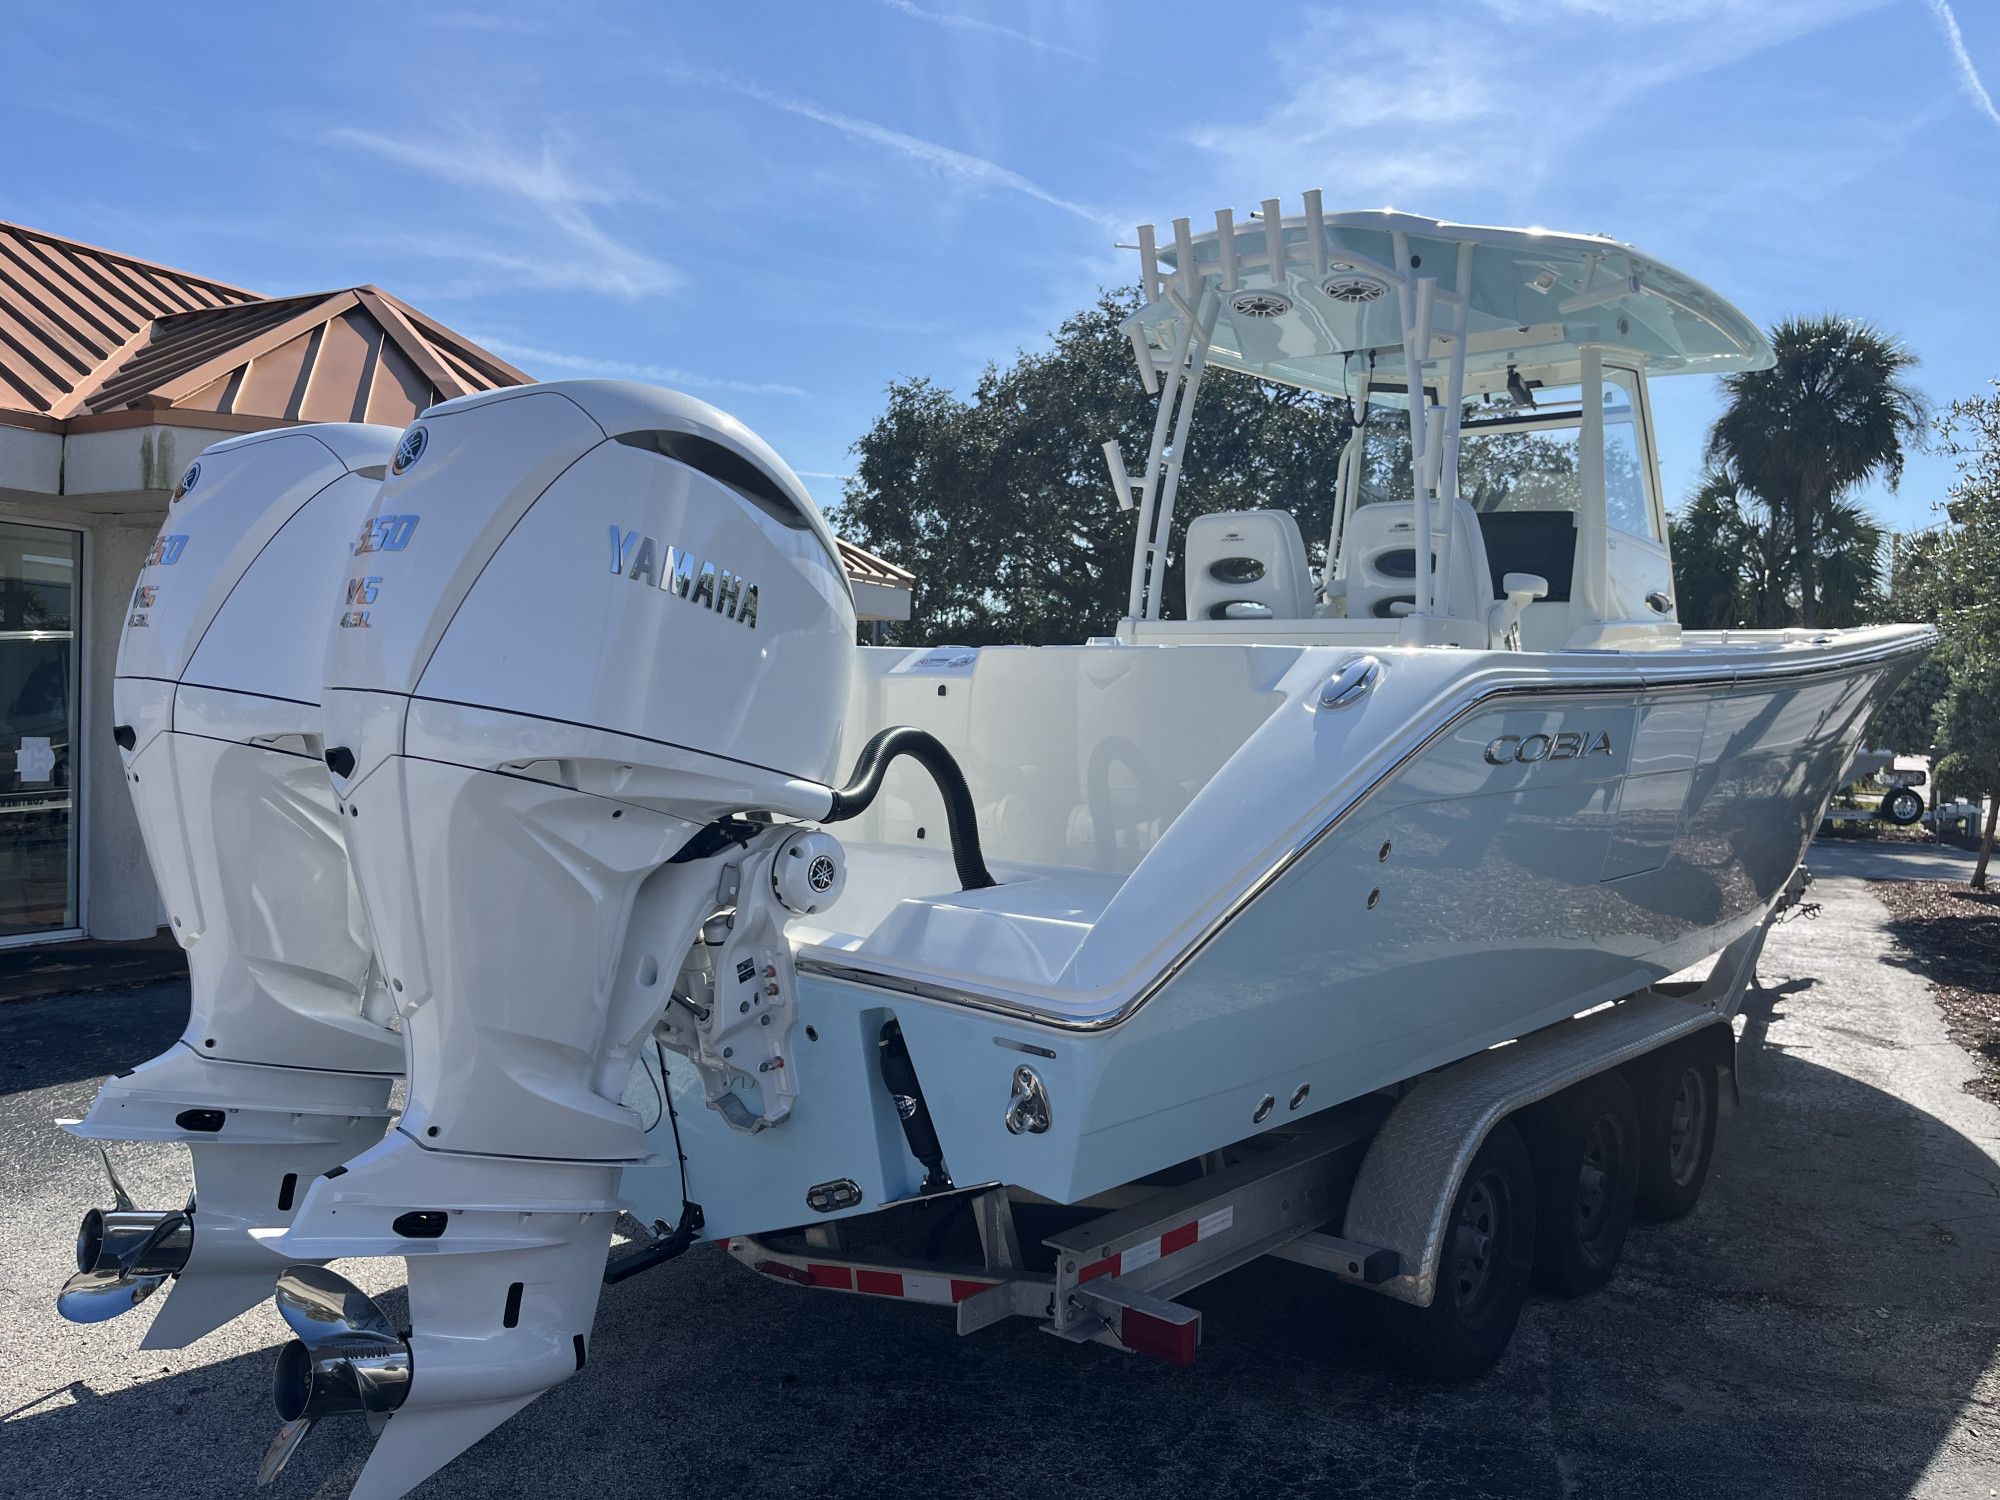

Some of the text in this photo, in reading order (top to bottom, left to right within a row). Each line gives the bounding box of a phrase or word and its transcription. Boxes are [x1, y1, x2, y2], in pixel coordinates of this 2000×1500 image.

[144, 534, 189, 569] 50
[608, 524, 760, 630] YAMAHA
[1484, 730, 1613, 765] COBIA
